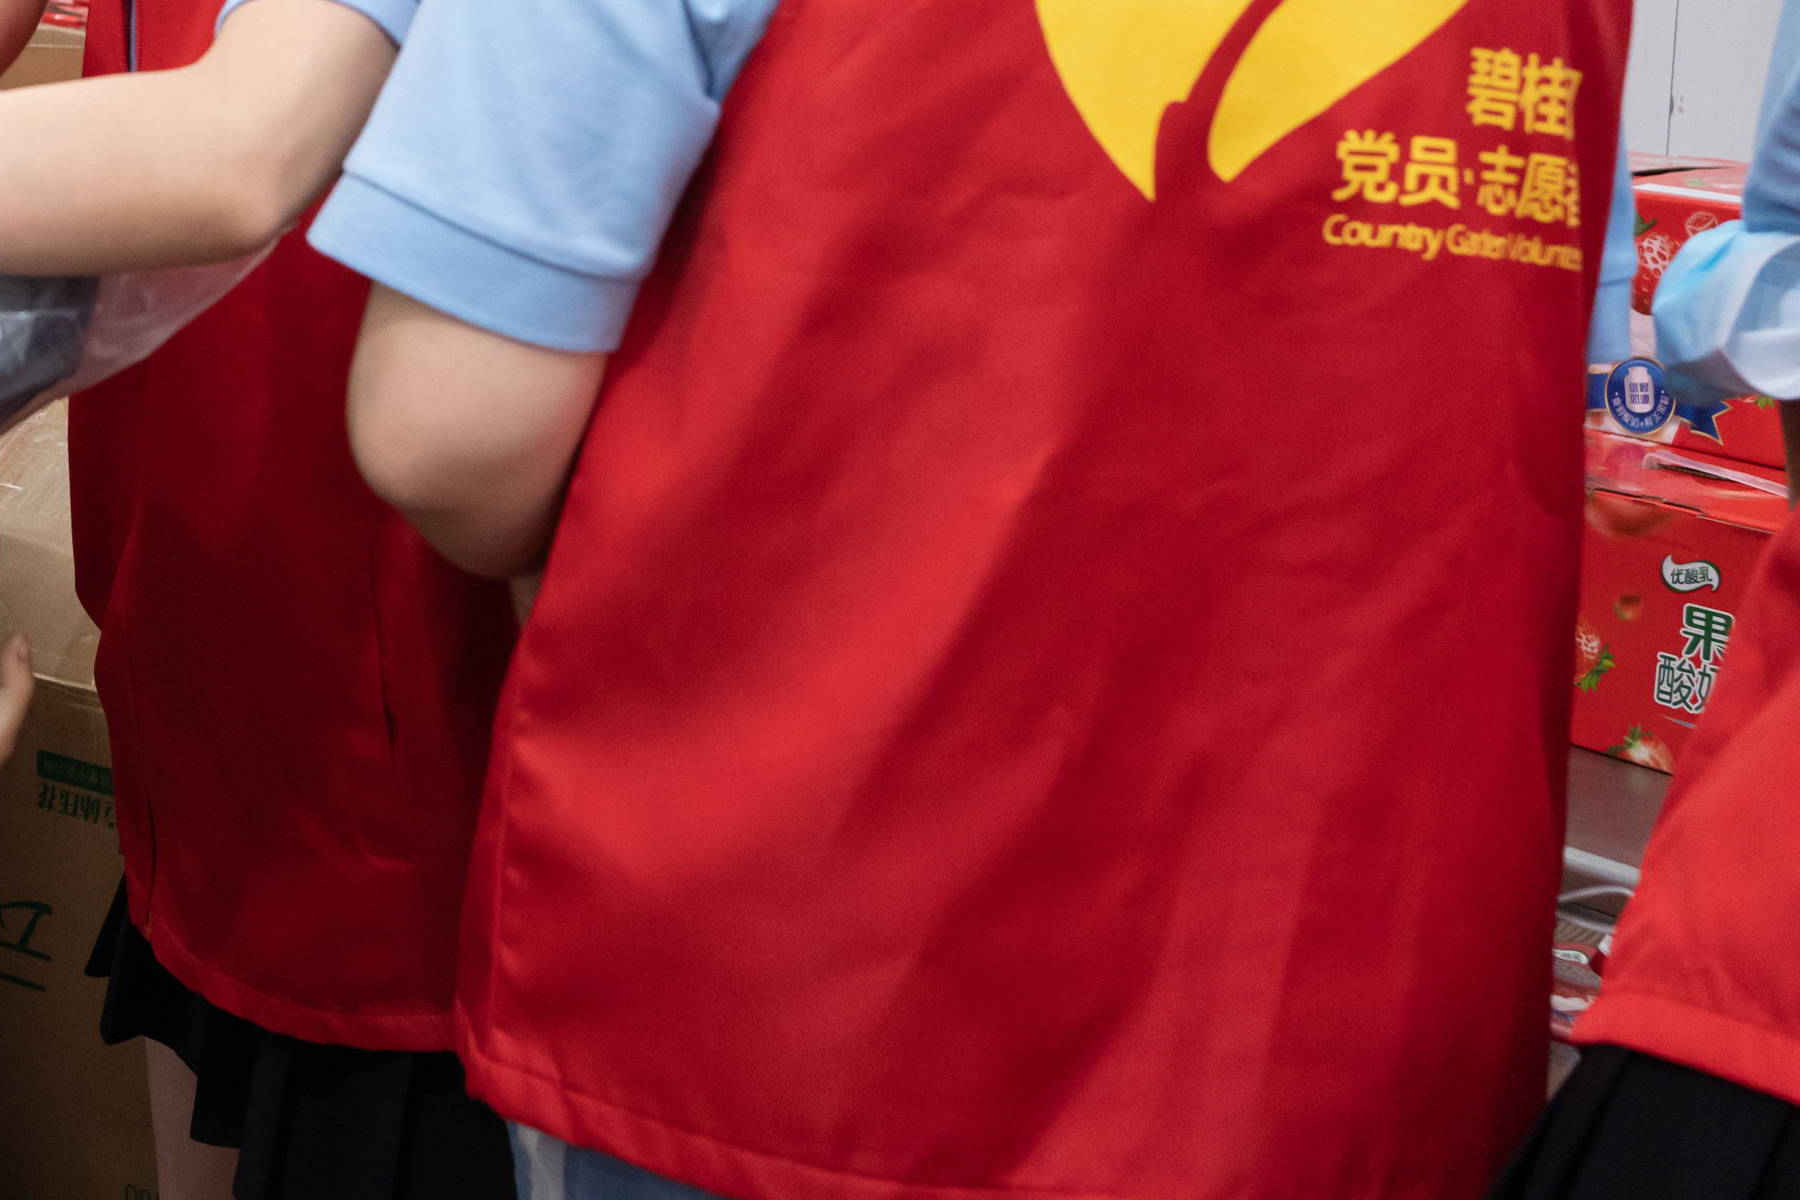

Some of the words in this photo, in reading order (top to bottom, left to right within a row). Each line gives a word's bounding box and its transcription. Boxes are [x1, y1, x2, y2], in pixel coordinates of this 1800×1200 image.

[1466, 47, 1583, 140] 碧桂
[1322, 212, 1443, 261] Country
[1670, 566, 1713, 586] 优酸乳
